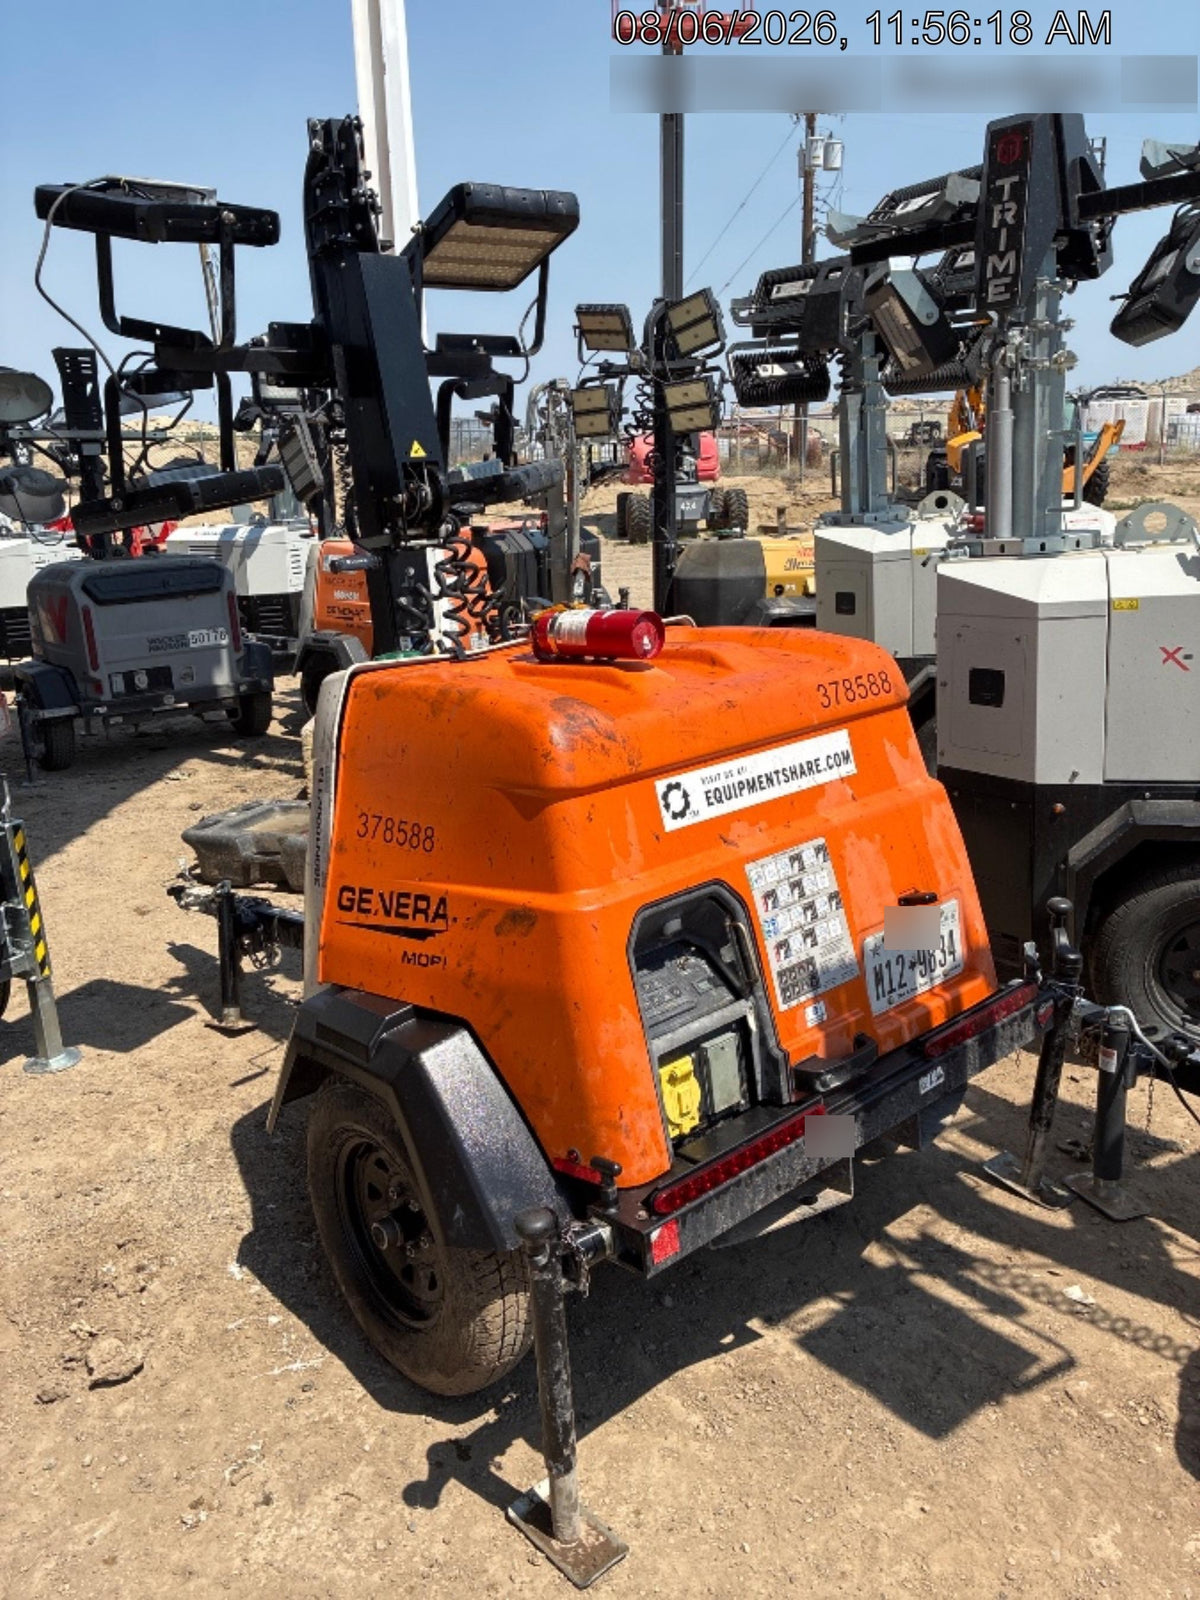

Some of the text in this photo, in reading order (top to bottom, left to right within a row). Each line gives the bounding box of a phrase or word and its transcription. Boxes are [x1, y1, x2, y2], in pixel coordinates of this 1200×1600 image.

[986, 175, 1020, 303] TRIME
[816, 670, 892, 709] 378588
[704, 749, 852, 807] EQUIPMENTSHARE.COM
[356, 811, 435, 853] 378588
